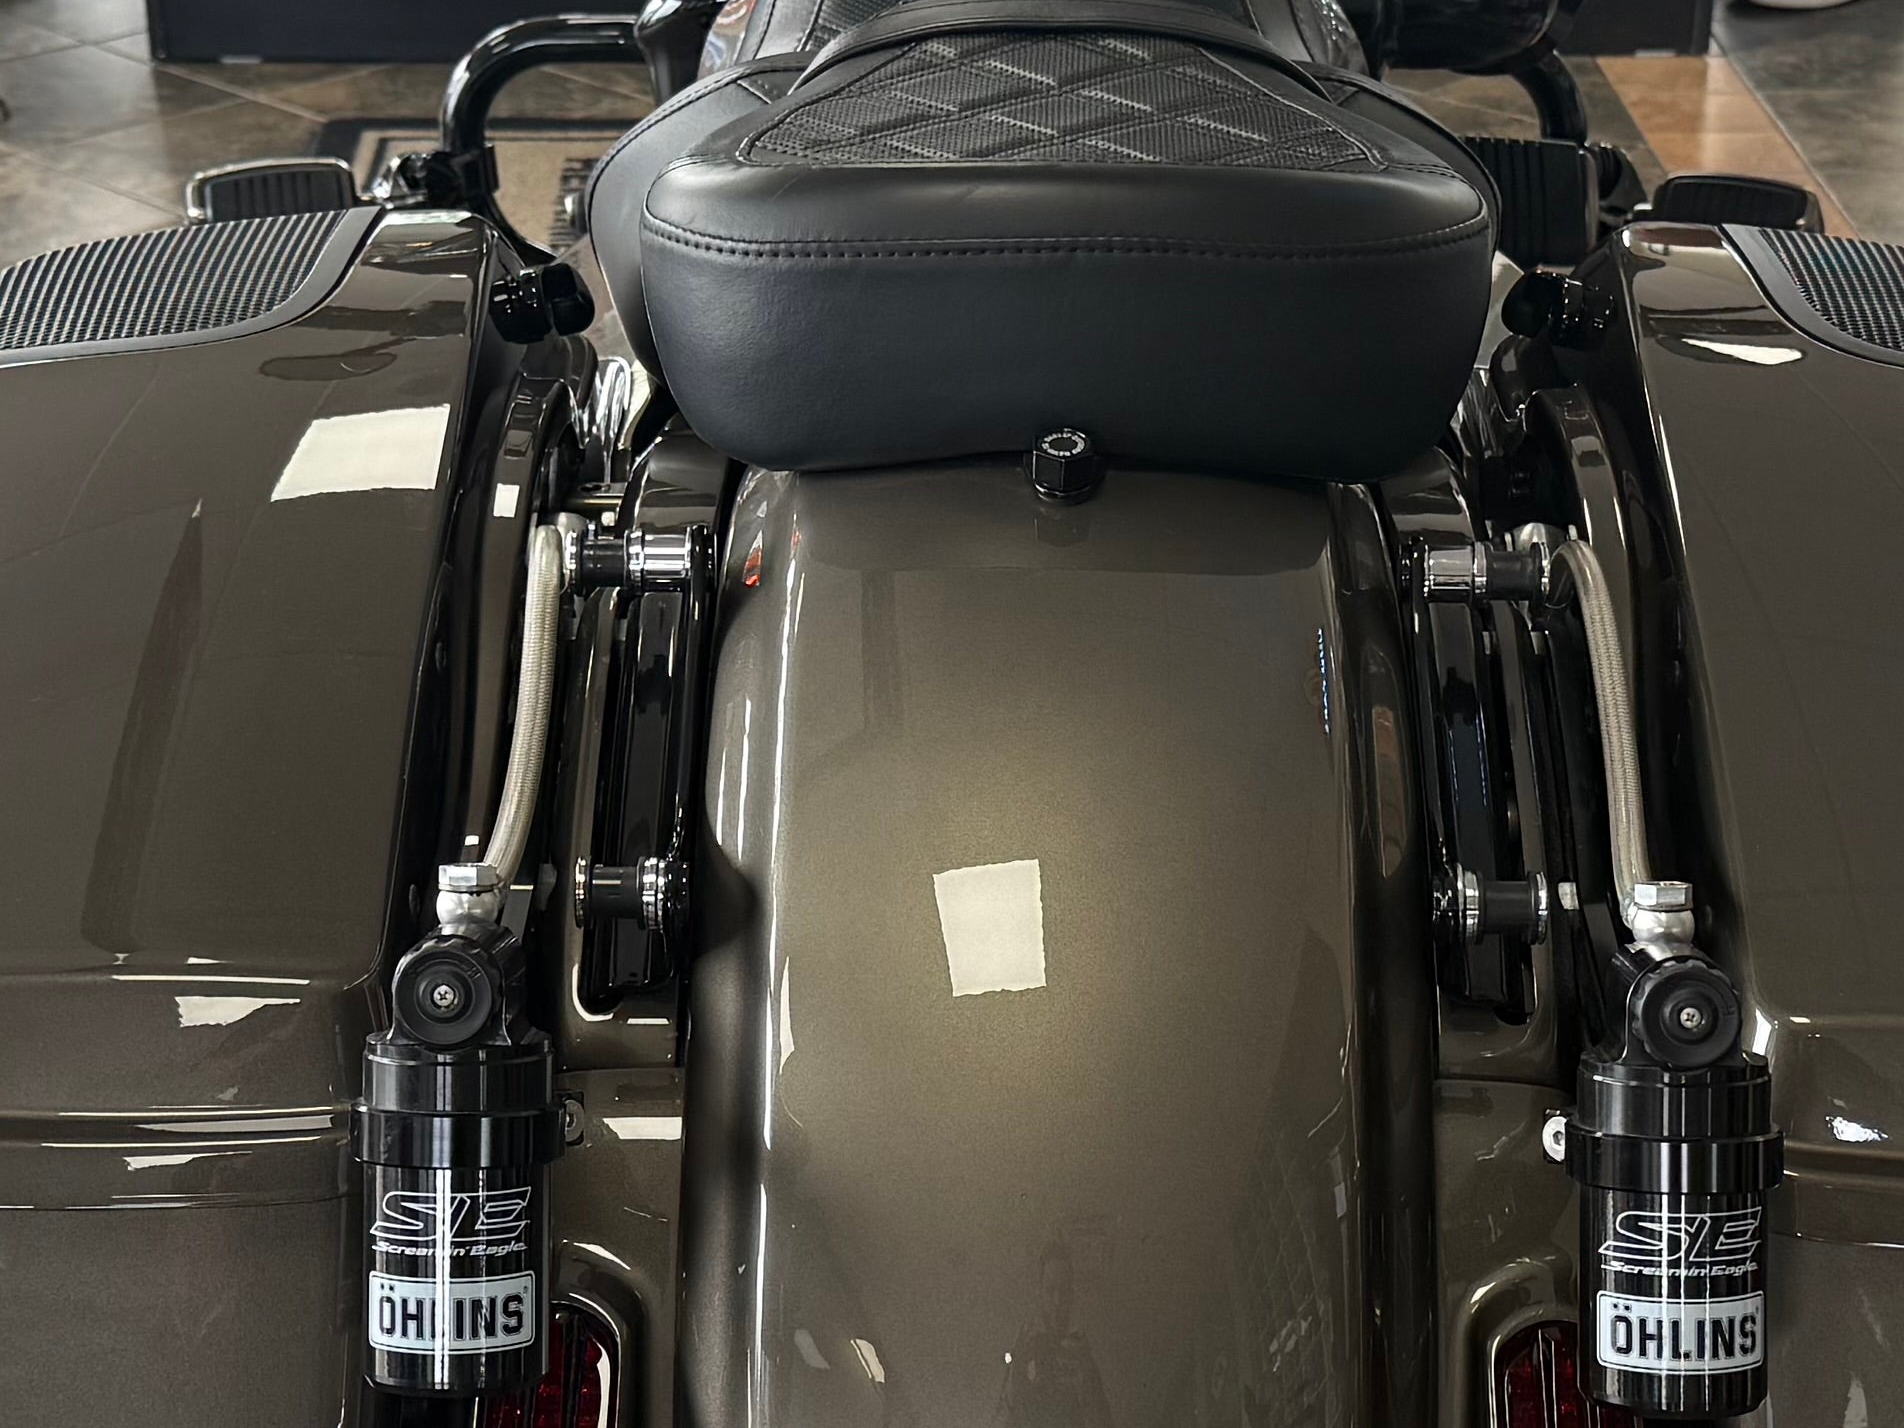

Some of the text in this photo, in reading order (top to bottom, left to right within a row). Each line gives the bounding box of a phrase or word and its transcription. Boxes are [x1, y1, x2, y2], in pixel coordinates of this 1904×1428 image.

[469, 1240, 529, 1258] Eagle
[1710, 1260, 1760, 1277] Eagle
[1610, 1302, 1758, 1362] ÖHLINS
